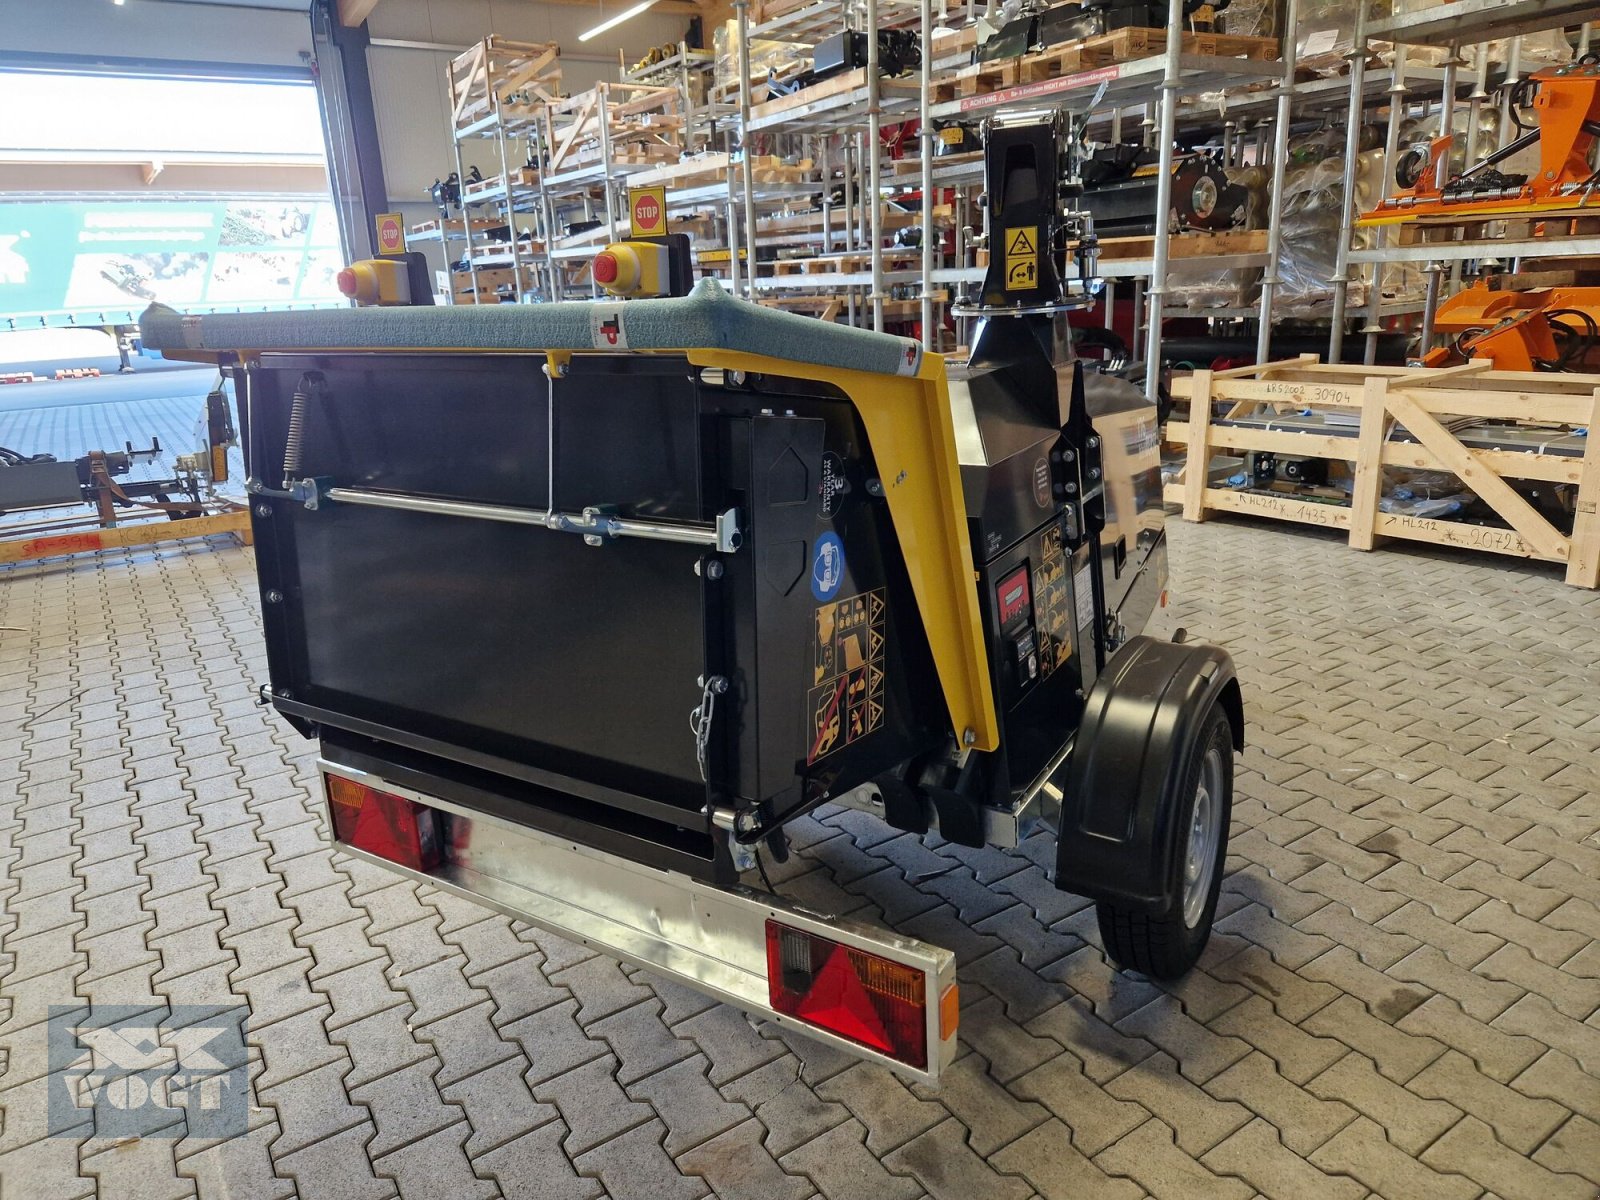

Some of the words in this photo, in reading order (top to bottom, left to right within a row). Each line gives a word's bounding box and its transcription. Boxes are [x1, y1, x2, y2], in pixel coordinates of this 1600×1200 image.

[970, 95, 997, 107] ACHTUNG
[636, 206, 658, 219] STOP
[382, 229, 398, 240] STOP
[834, 478, 843, 490] 3
